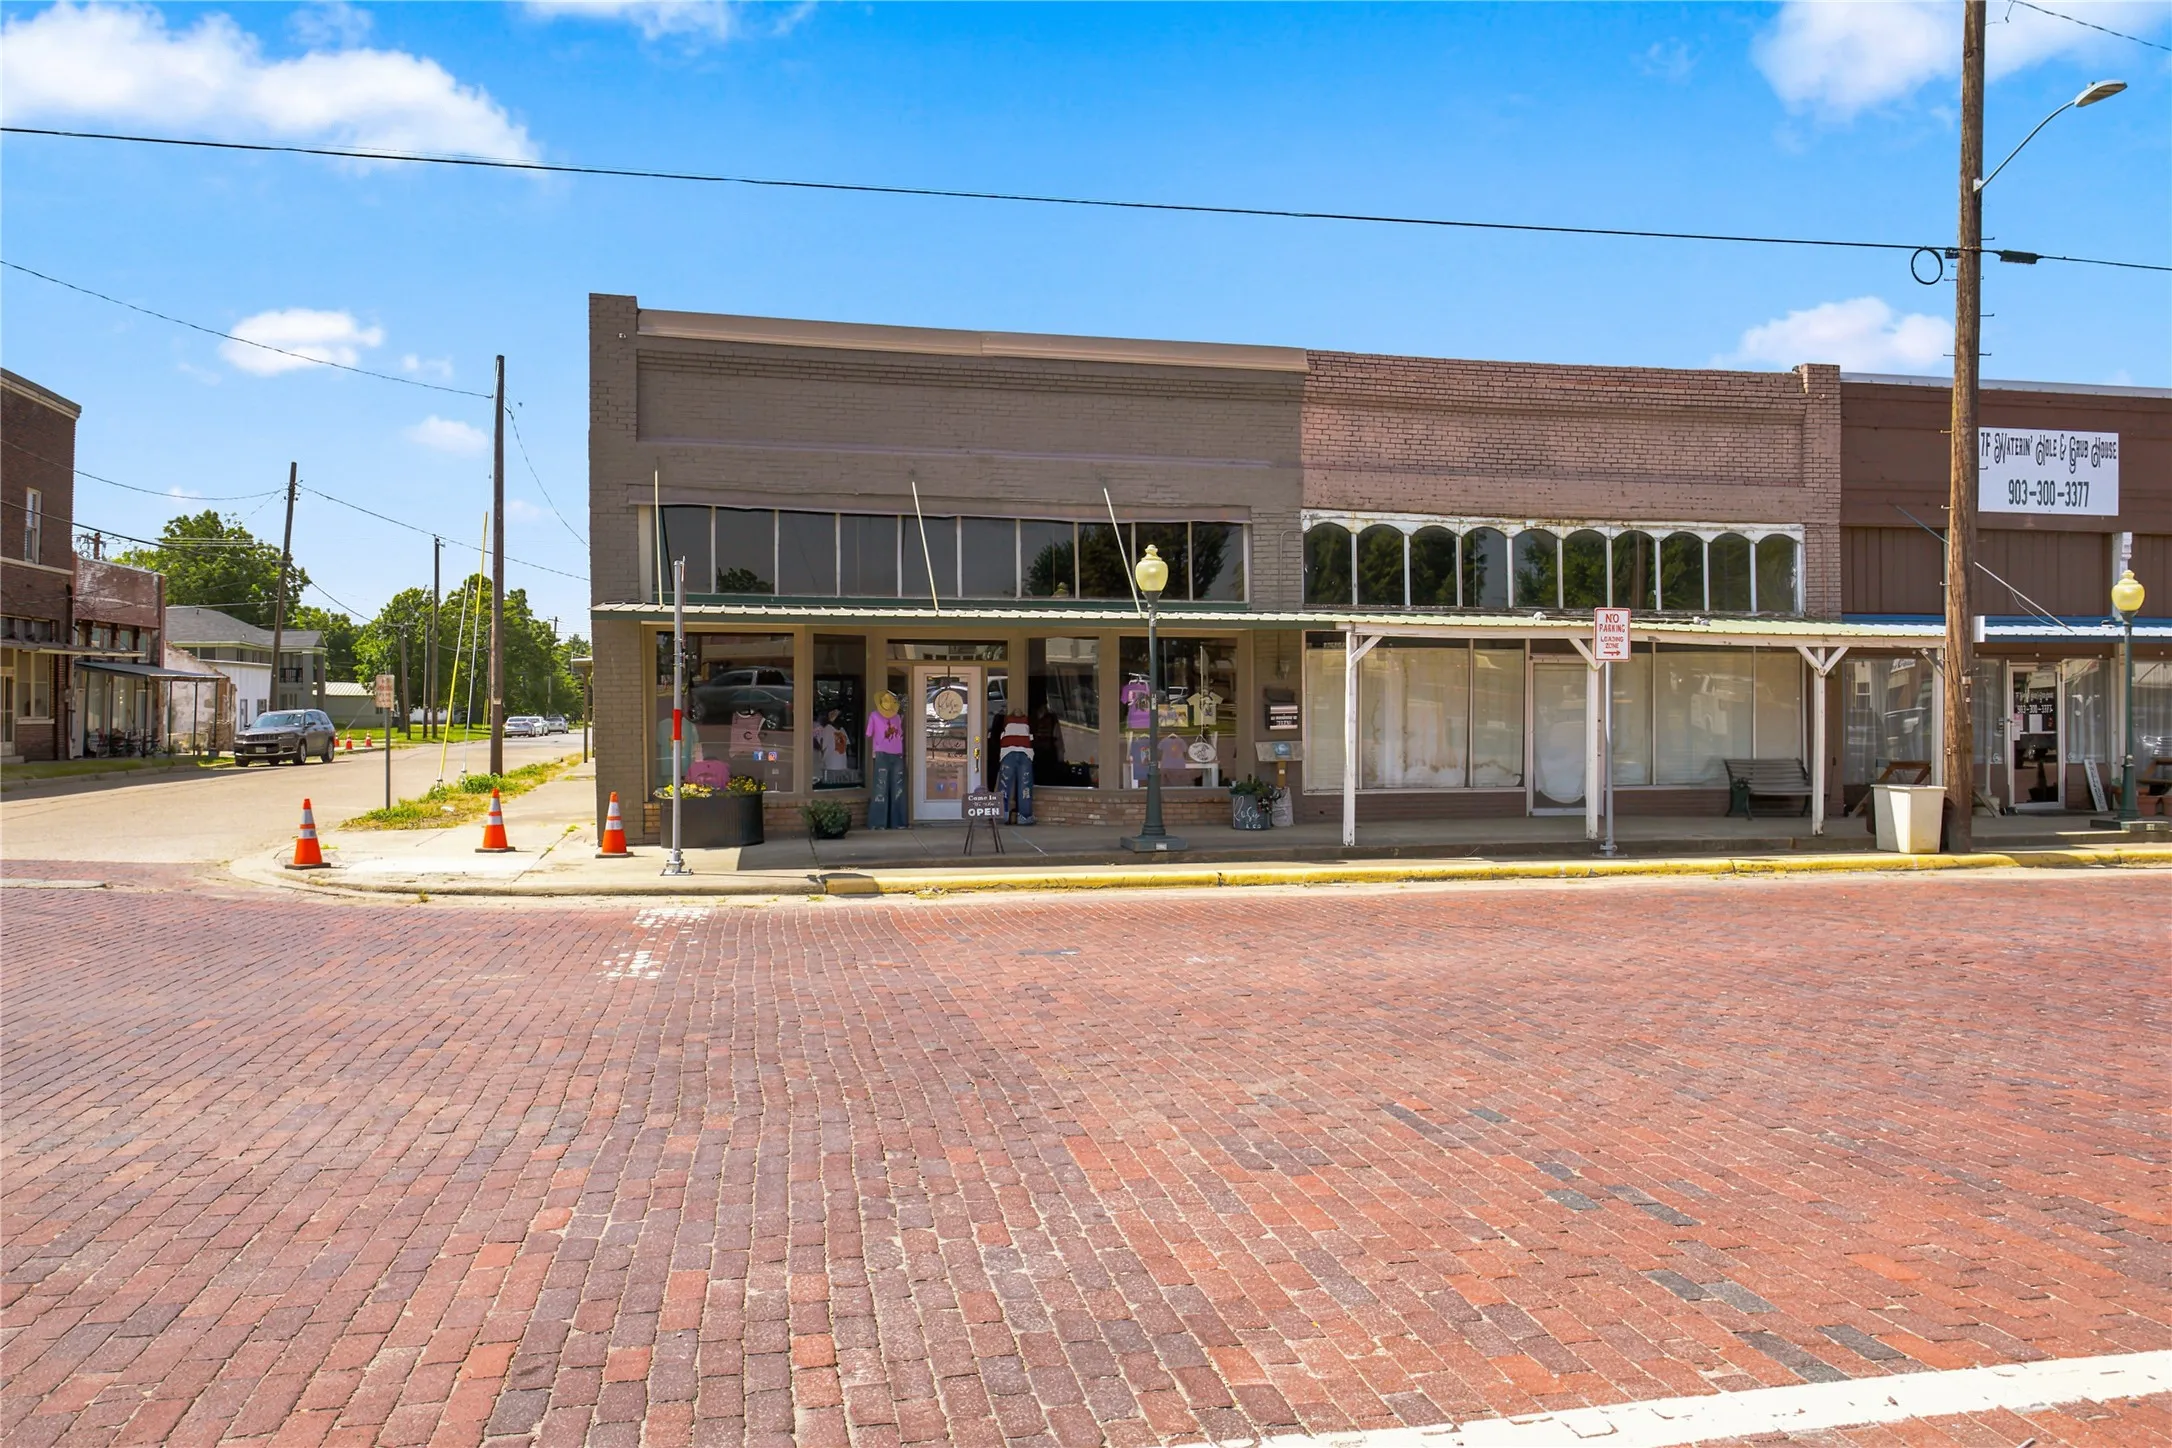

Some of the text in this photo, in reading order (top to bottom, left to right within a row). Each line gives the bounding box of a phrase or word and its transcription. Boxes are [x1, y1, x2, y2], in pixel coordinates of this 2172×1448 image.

[2008, 478, 2090, 508] 903-300-3377
[1605, 613, 1619, 623] NO
[1599, 623, 1625, 633] PARKING
[967, 807, 1000, 817] OPEN
